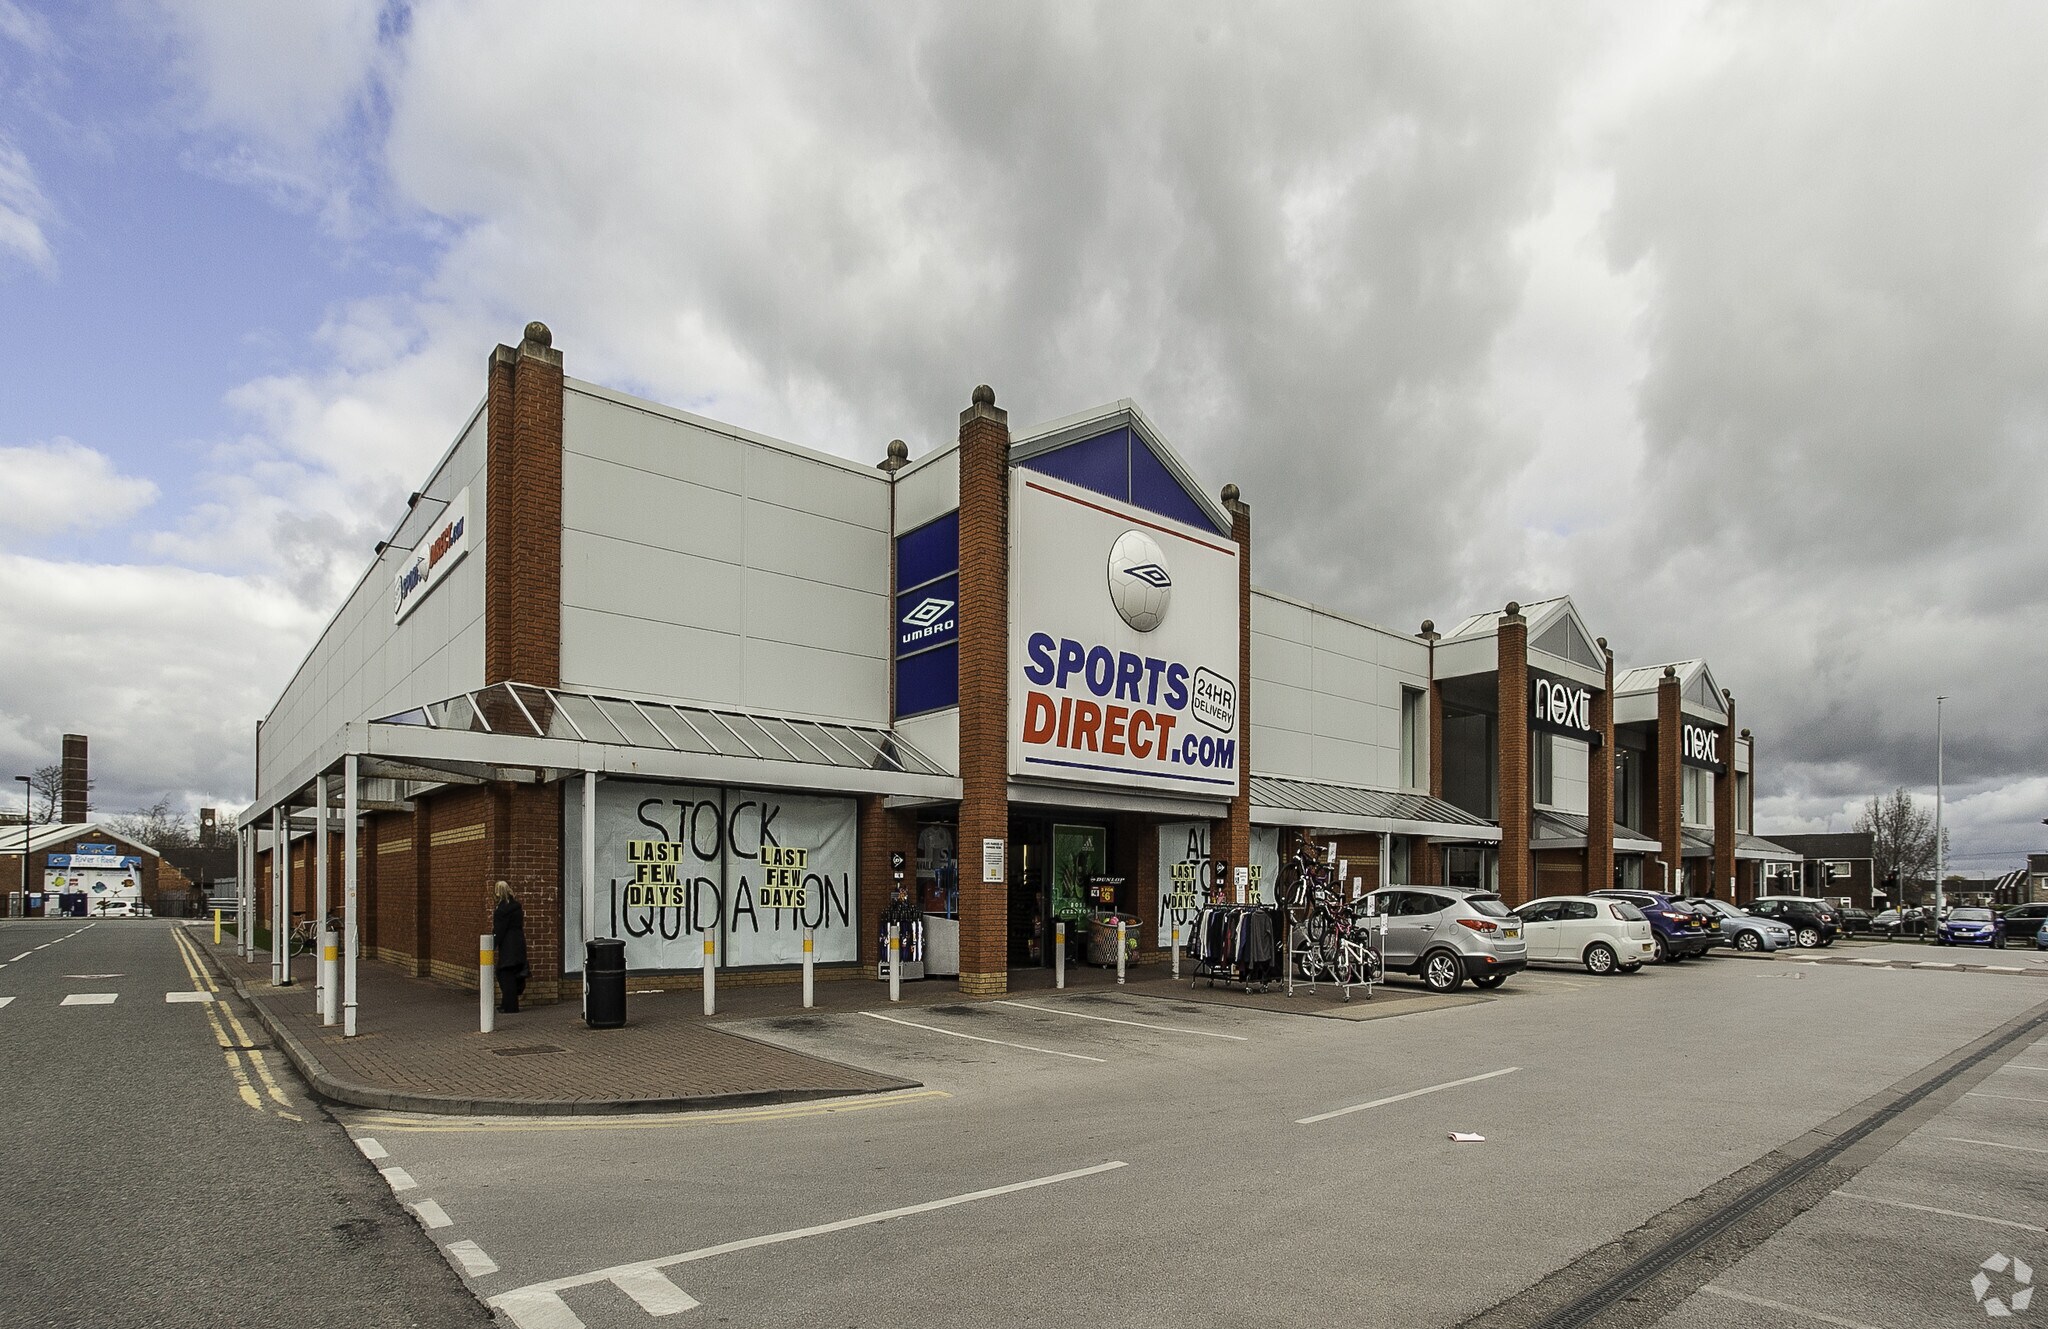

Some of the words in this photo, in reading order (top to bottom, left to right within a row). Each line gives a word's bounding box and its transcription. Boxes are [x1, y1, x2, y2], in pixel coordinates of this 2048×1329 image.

[1024, 632, 1190, 711] SPORTS
[1197, 678, 1232, 709] 24HR
[1194, 697, 1232, 724] DELIVERY
[1536, 678, 1591, 731] next
[1684, 724, 1720, 764] next
[637, 798, 781, 862] STOCK
[629, 841, 682, 862] LAST
[1186, 827, 1210, 859] AL
[760, 847, 807, 867] LAST
[636, 864, 676, 883] FEW
[766, 869, 801, 887] FEW
[1171, 865, 1195, 878] LAST
[1250, 865, 1262, 877] ST
[629, 886, 684, 905] DAYS
[760, 888, 805, 906] DAYS
[1171, 895, 1196, 908] DAYS
[1250, 893, 1261, 904] YS
